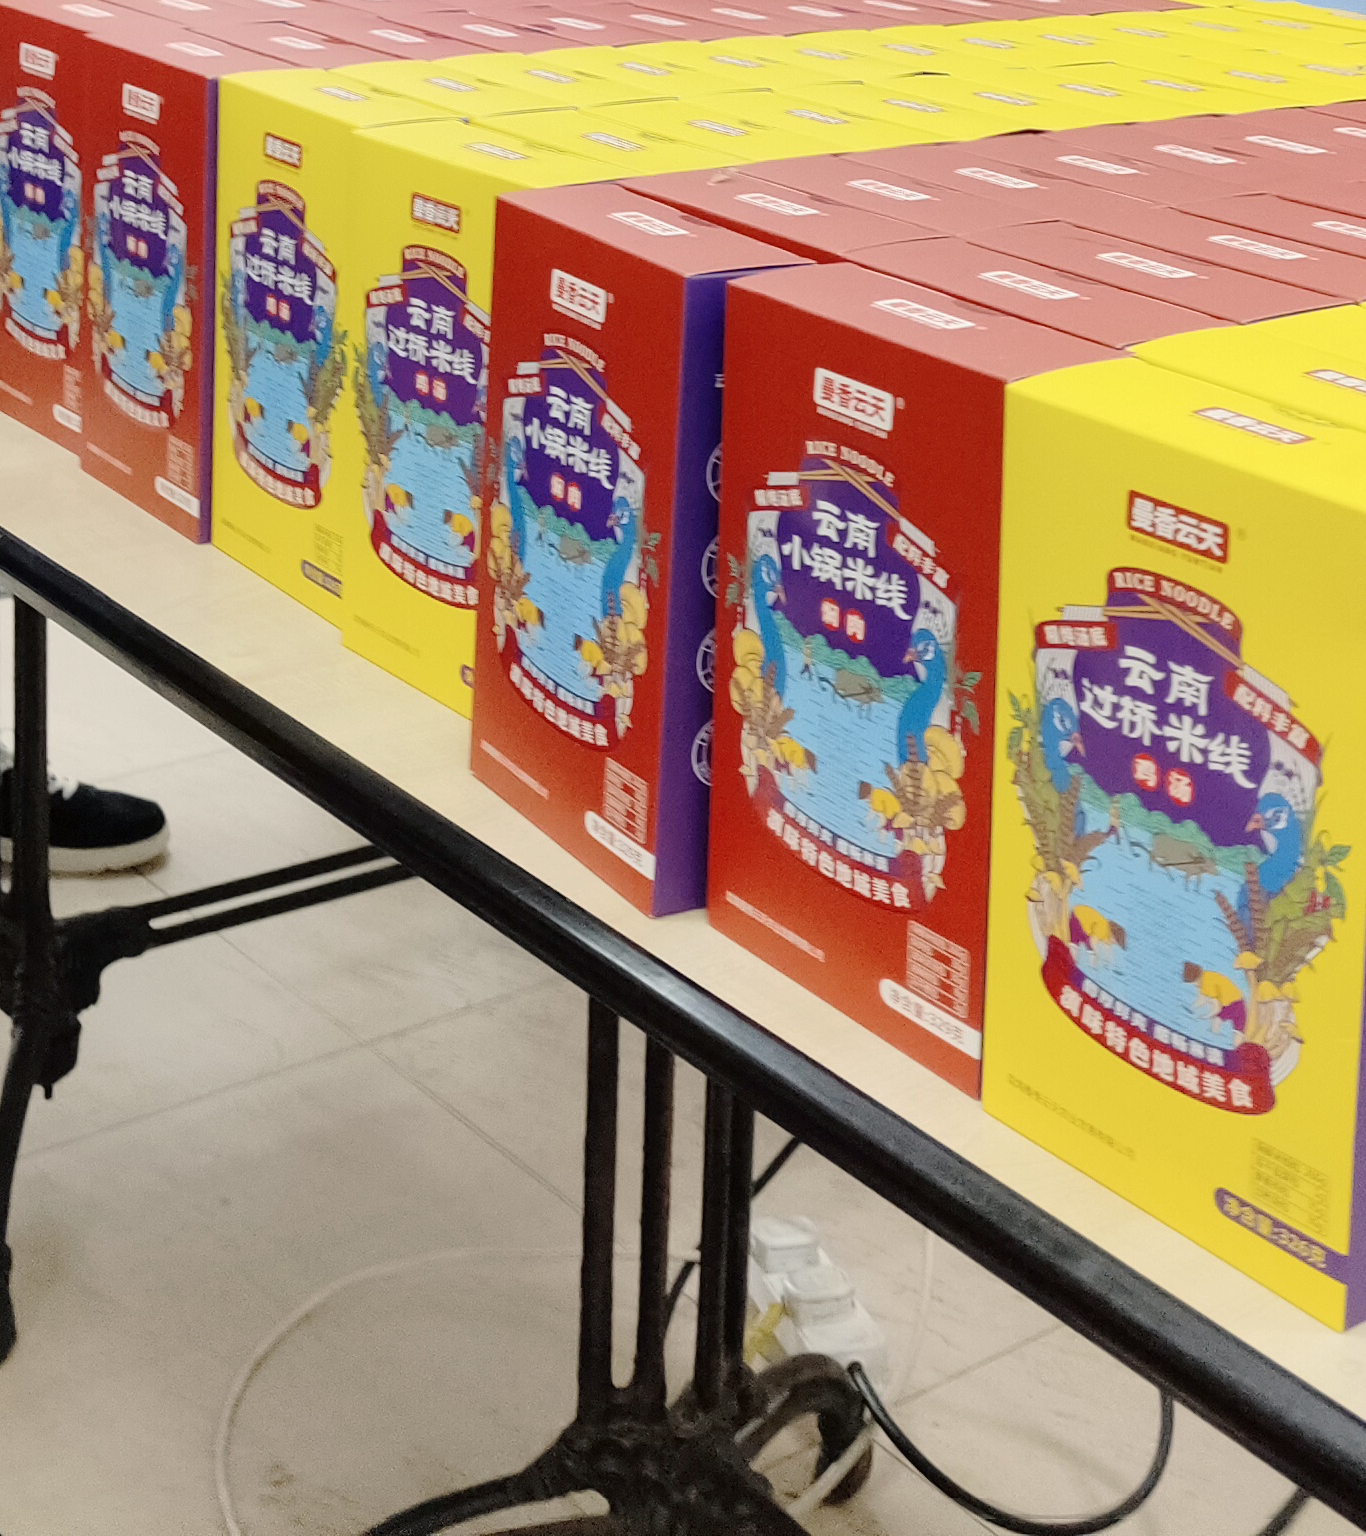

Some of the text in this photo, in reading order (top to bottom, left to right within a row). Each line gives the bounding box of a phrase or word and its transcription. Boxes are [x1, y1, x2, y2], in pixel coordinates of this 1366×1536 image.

[406, 297, 457, 341] 云南
[387, 325, 479, 385] 过桥米线
[546, 385, 595, 437] 云南
[820, 375, 886, 423] 曼香云天
[525, 417, 616, 491] 小锅米线
[804, 440, 897, 488] RICE NOODLE
[812, 499, 881, 559] 云南
[1129, 496, 1226, 558] 曼香云天
[781, 534, 914, 622] 小锅米线
[1112, 570, 1237, 631] RICE NOODLE
[1118, 644, 1216, 718] 云南
[1078, 676, 1259, 790] 过桥米线
